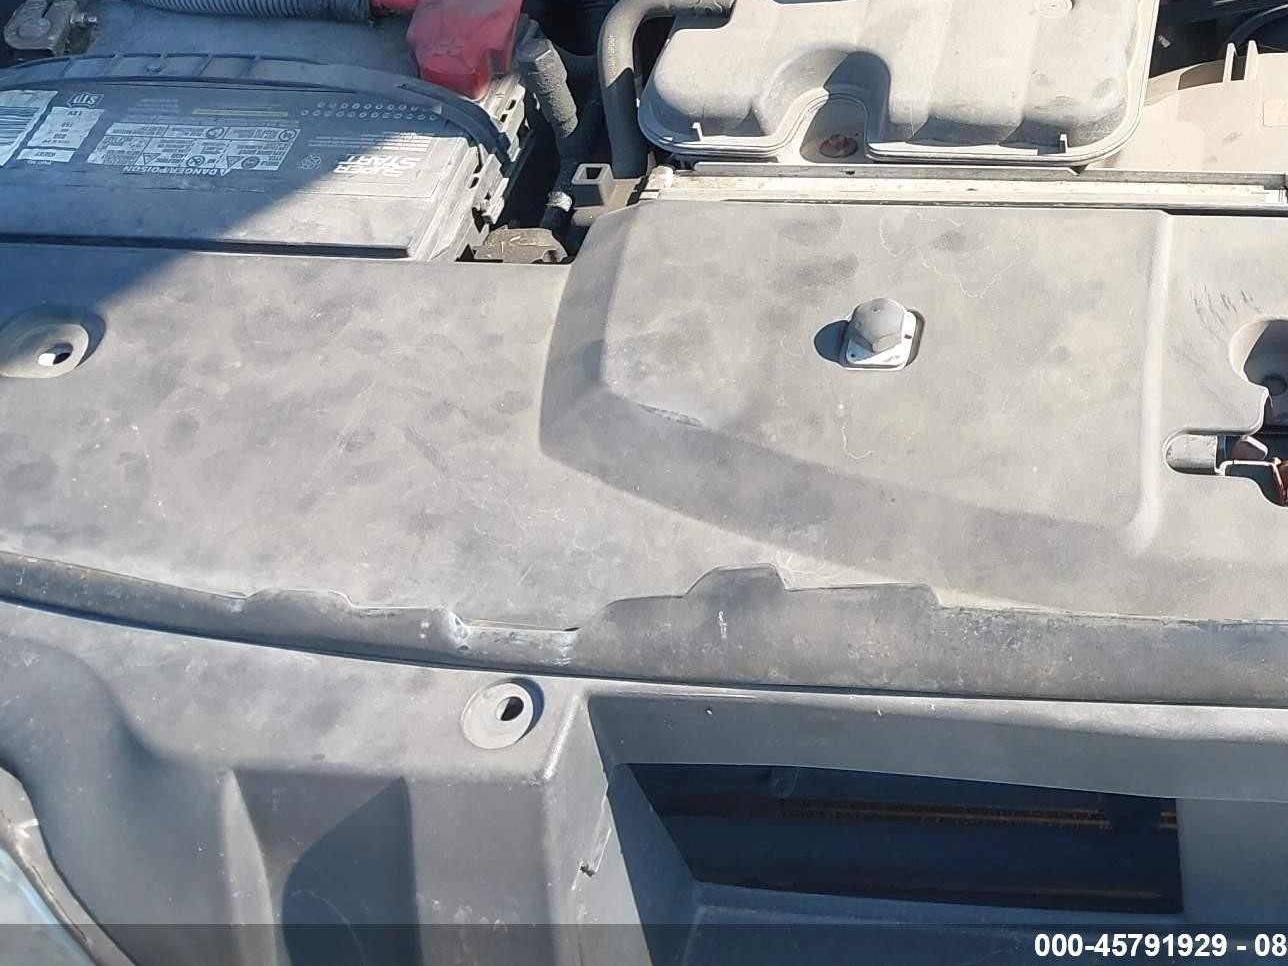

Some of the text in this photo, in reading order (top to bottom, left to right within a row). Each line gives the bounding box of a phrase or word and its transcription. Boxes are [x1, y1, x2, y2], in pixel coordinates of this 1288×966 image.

[72, 94, 99, 105] STP
[337, 154, 424, 170] START
[122, 165, 219, 176] DANGER/POISON
[332, 164, 404, 178] SUPER
